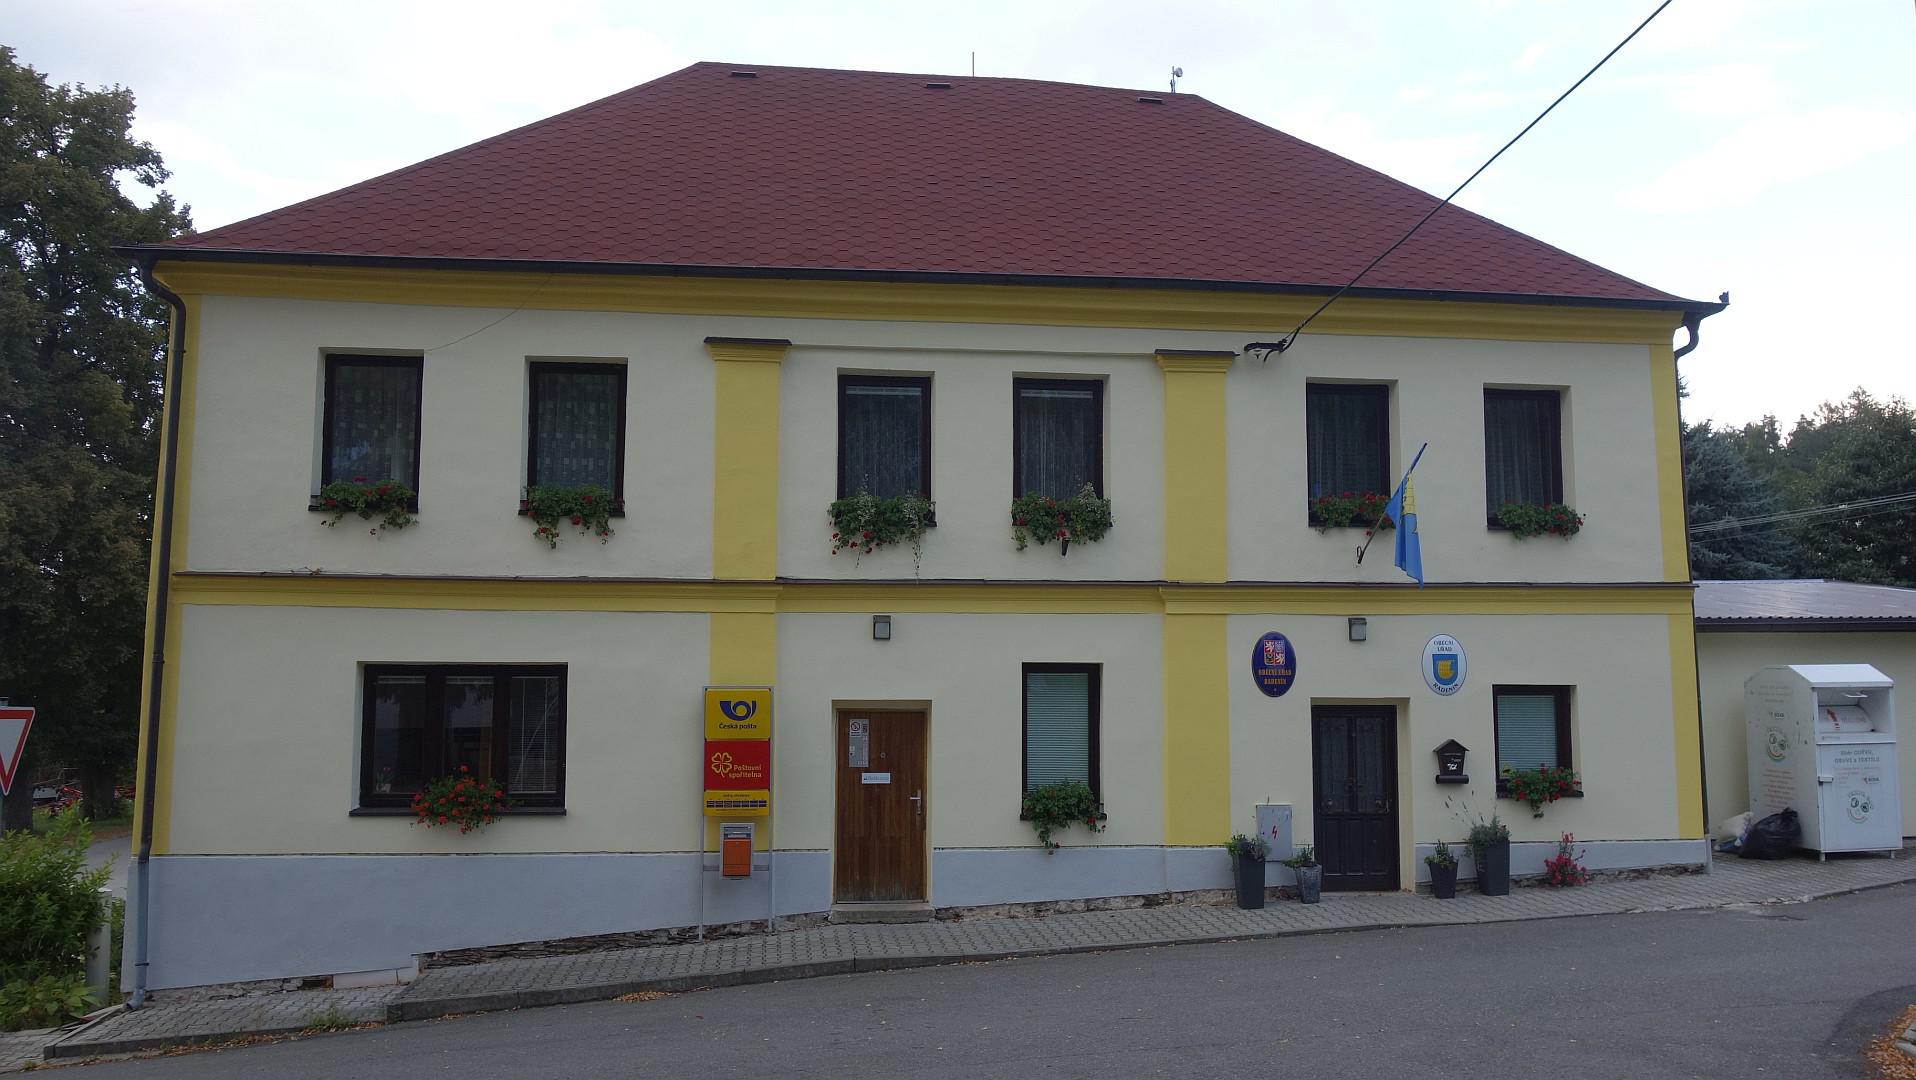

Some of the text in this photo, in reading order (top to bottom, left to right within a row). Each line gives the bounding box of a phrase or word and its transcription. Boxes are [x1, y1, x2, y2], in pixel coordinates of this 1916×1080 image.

[719, 721, 757, 731] Česká pošta
[733, 763, 762, 771] Poštovní
[728, 771, 762, 780] spořitelna
